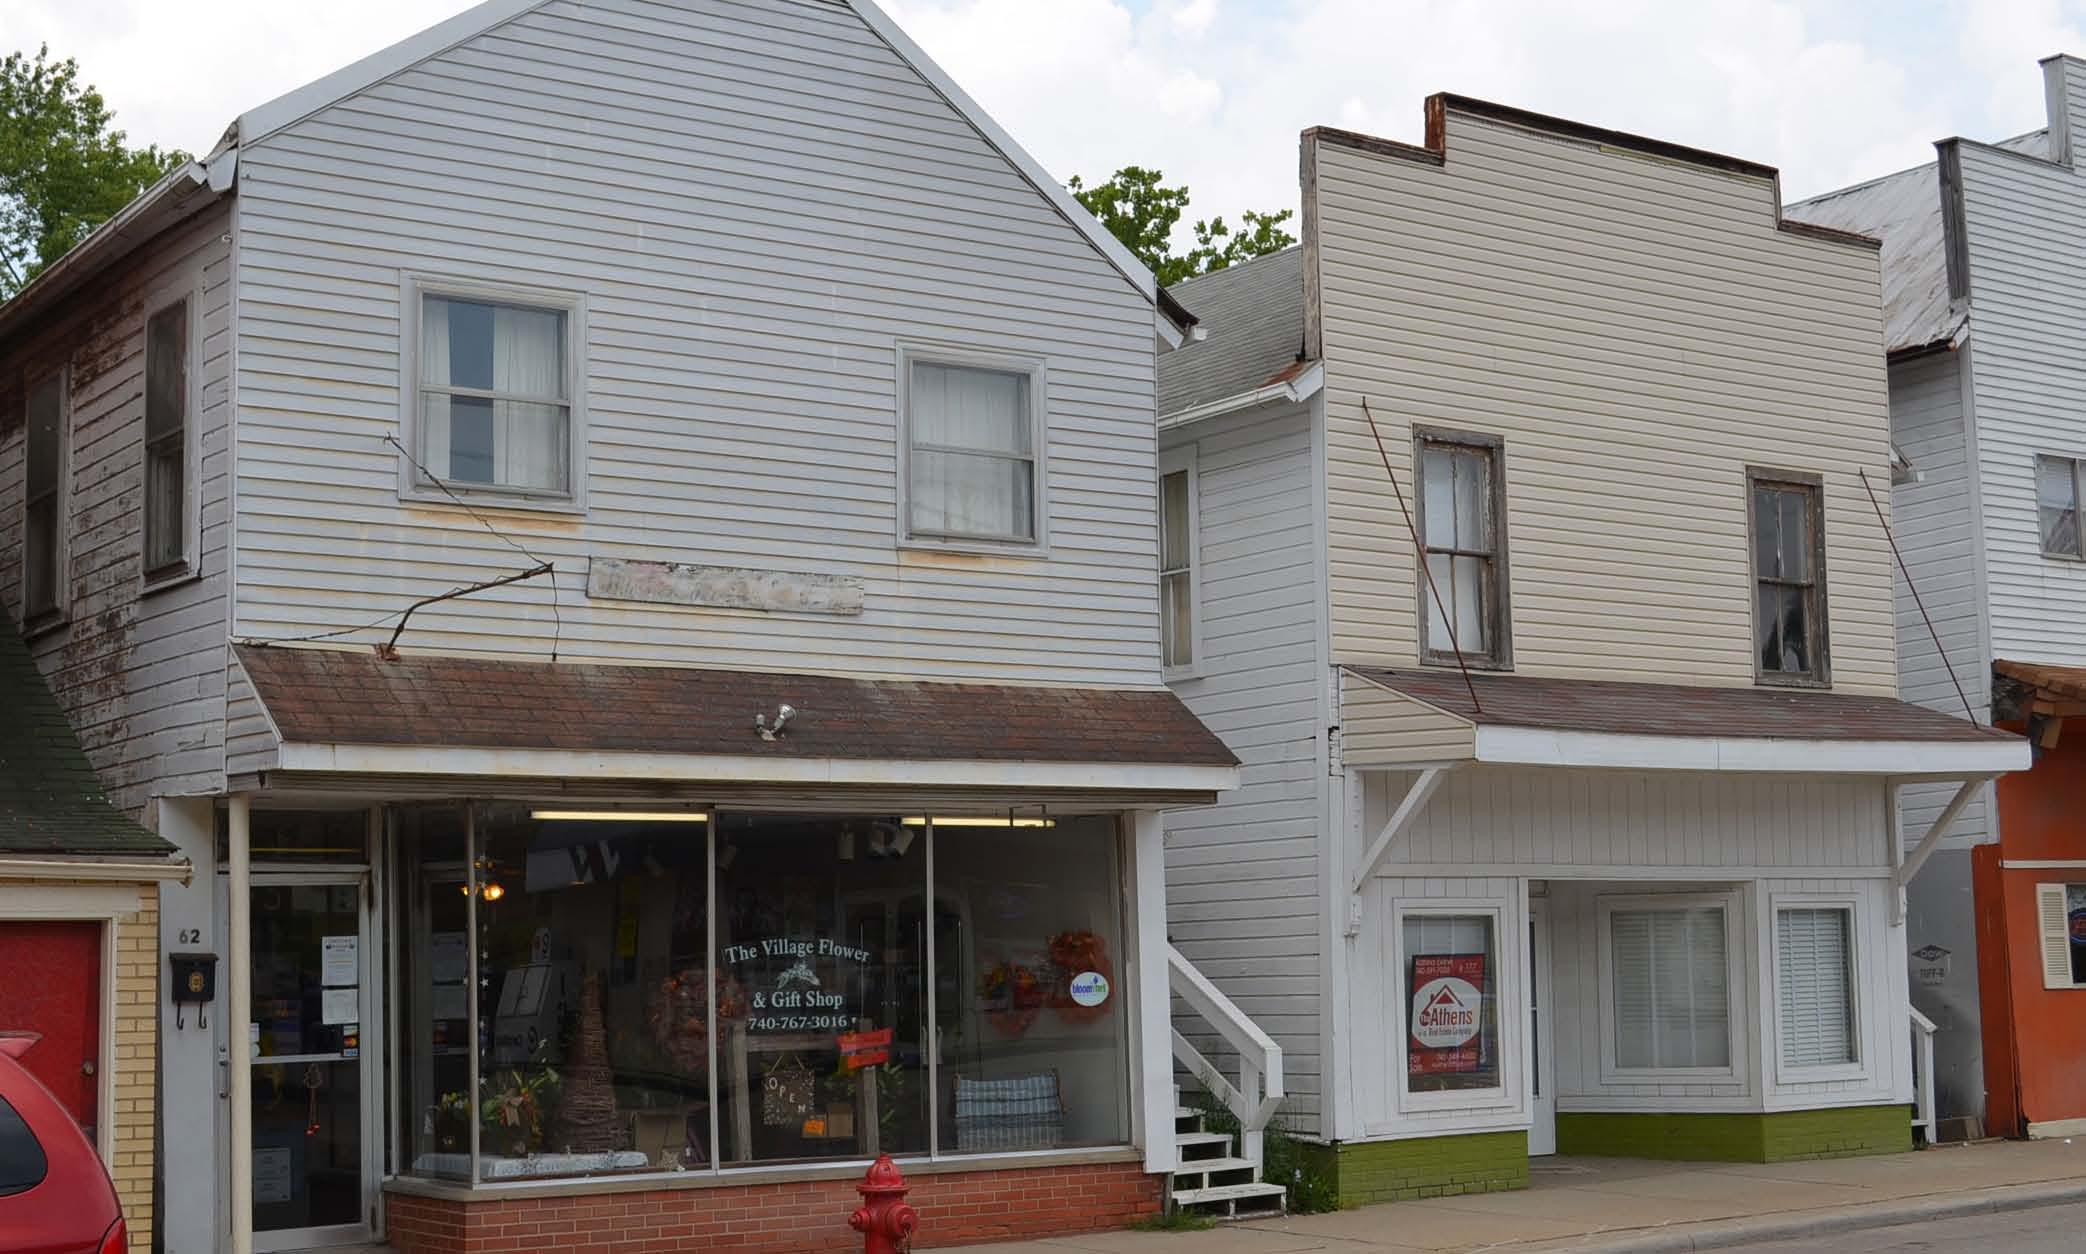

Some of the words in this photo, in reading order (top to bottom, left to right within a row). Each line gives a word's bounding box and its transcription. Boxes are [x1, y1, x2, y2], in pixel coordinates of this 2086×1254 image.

[179, 929, 200, 945] 62
[725, 945, 758, 964] The
[761, 938, 814, 957] Village
[818, 938, 870, 963] Flower
[753, 991, 766, 1009] &
[771, 991, 802, 1008] Gift
[806, 990, 843, 1009] Shop
[748, 1015, 848, 1030] 740-767-3016
[768, 1077, 806, 1113] OPEN
